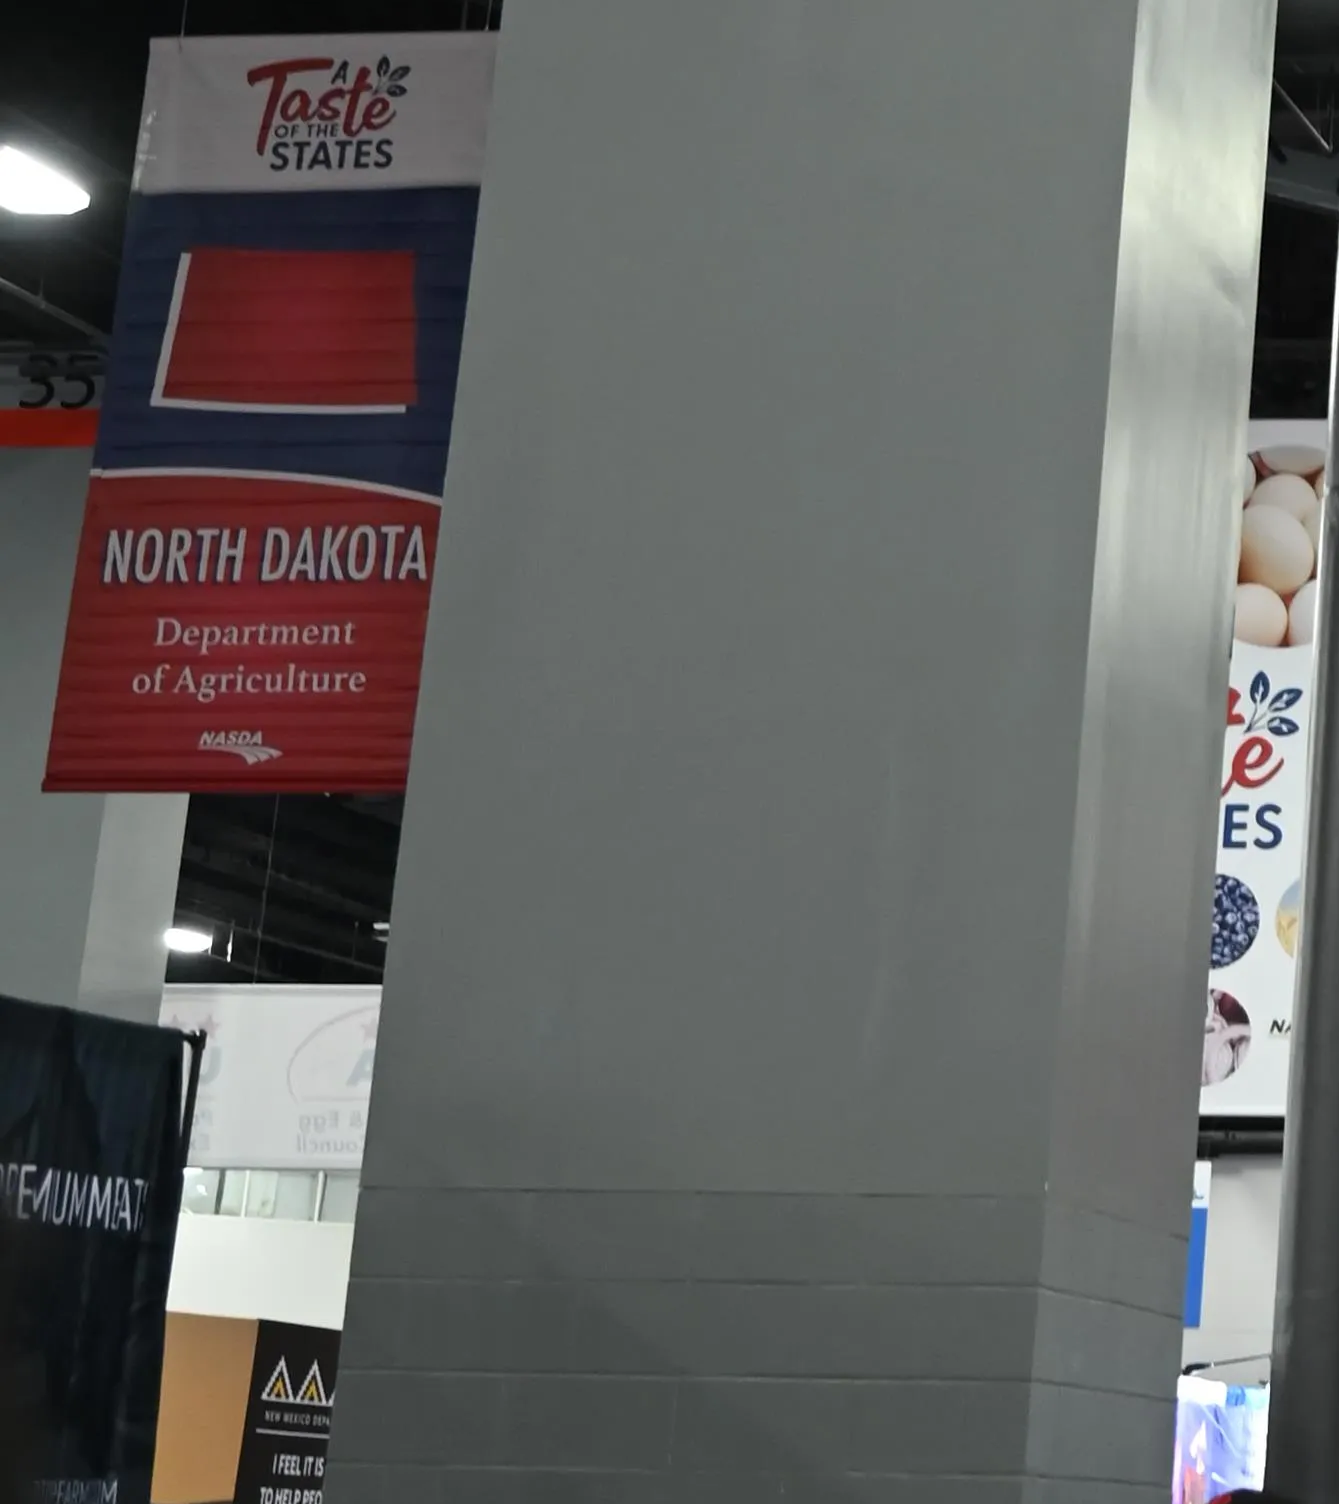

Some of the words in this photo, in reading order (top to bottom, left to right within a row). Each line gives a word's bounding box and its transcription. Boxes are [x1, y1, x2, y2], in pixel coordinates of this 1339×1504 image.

[331, 59, 350, 85] A
[247, 57, 397, 156] Taste
[274, 124, 300, 139] OF
[307, 123, 340, 138] THE
[270, 139, 394, 172] STATES
[102, 528, 247, 584] NORTH
[260, 525, 427, 581] DAKOTA
[153, 617, 356, 655] Department
[132, 664, 170, 695] of
[173, 663, 367, 703] Agriculture
[199, 730, 263, 746] NASDA
[265, 1410, 281, 1423] NEW
[283, 1412, 311, 1426] MEXICO
[273, 1453, 278, 1474] I
[279, 1454, 302, 1475] FEEL
[303, 1455, 314, 1476] IT
[314, 1456, 325, 1477] IS
